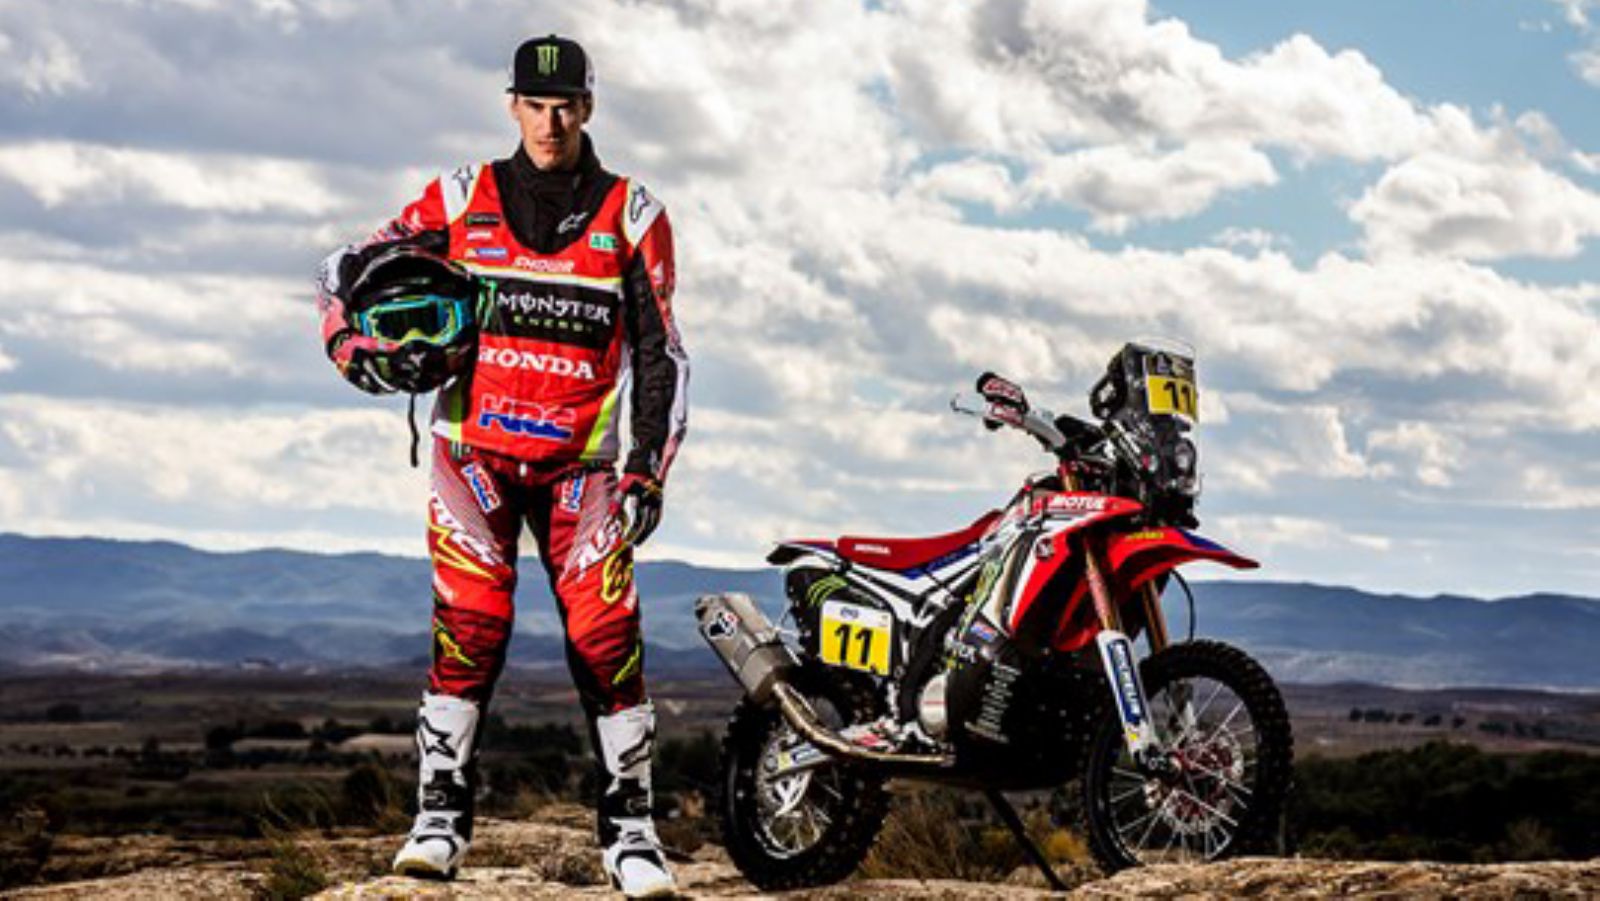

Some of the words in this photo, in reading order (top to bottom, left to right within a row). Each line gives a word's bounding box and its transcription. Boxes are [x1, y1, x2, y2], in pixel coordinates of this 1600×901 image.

[497, 291, 611, 326] MONSTER
[479, 345, 595, 380] HONDA
[1163, 381, 1192, 414] 11
[479, 392, 577, 443] HRC
[834, 623, 873, 667] 11
